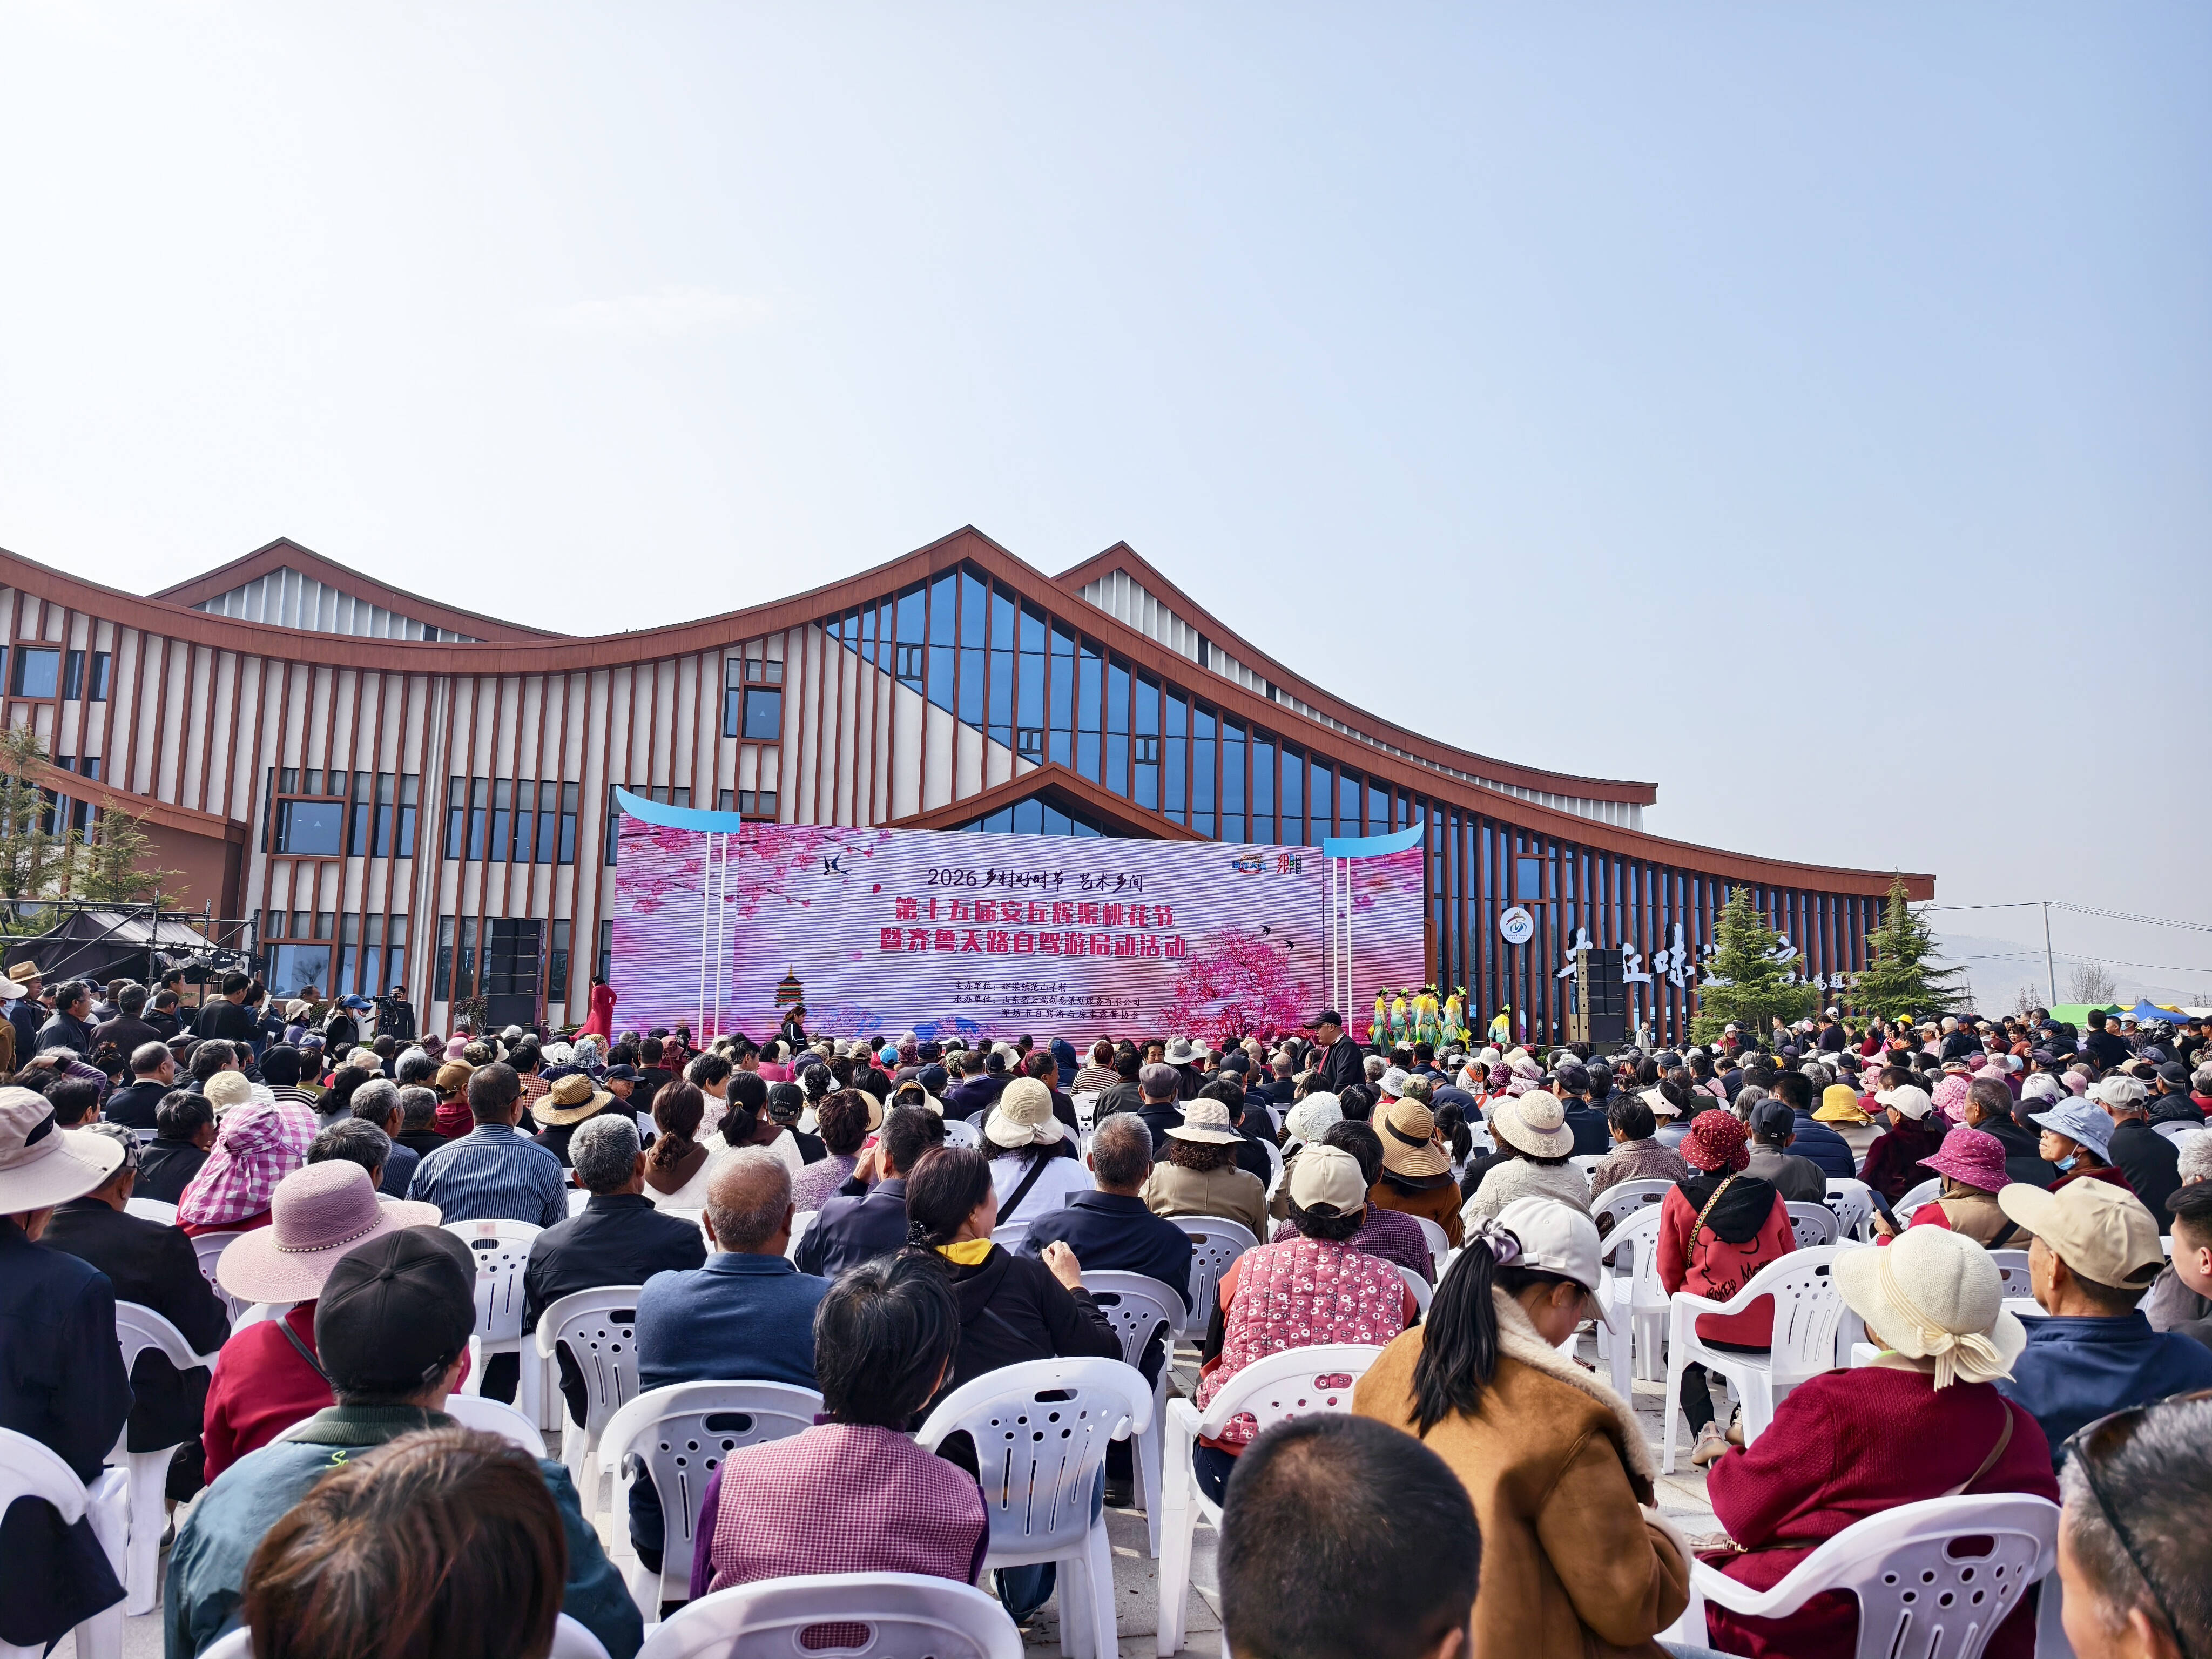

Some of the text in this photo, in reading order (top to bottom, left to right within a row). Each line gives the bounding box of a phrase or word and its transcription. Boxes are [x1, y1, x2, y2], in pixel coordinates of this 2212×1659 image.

[1080, 872, 1143, 893] 艺术乡间
[895, 896, 1175, 927] 第十五届安丘辉渠桃花节
[880, 928, 1186, 957] 暨齐鲁天路自驾游启动活动
[1001, 1009, 1141, 1020] 潍坊市自驾游与房车露营协会
